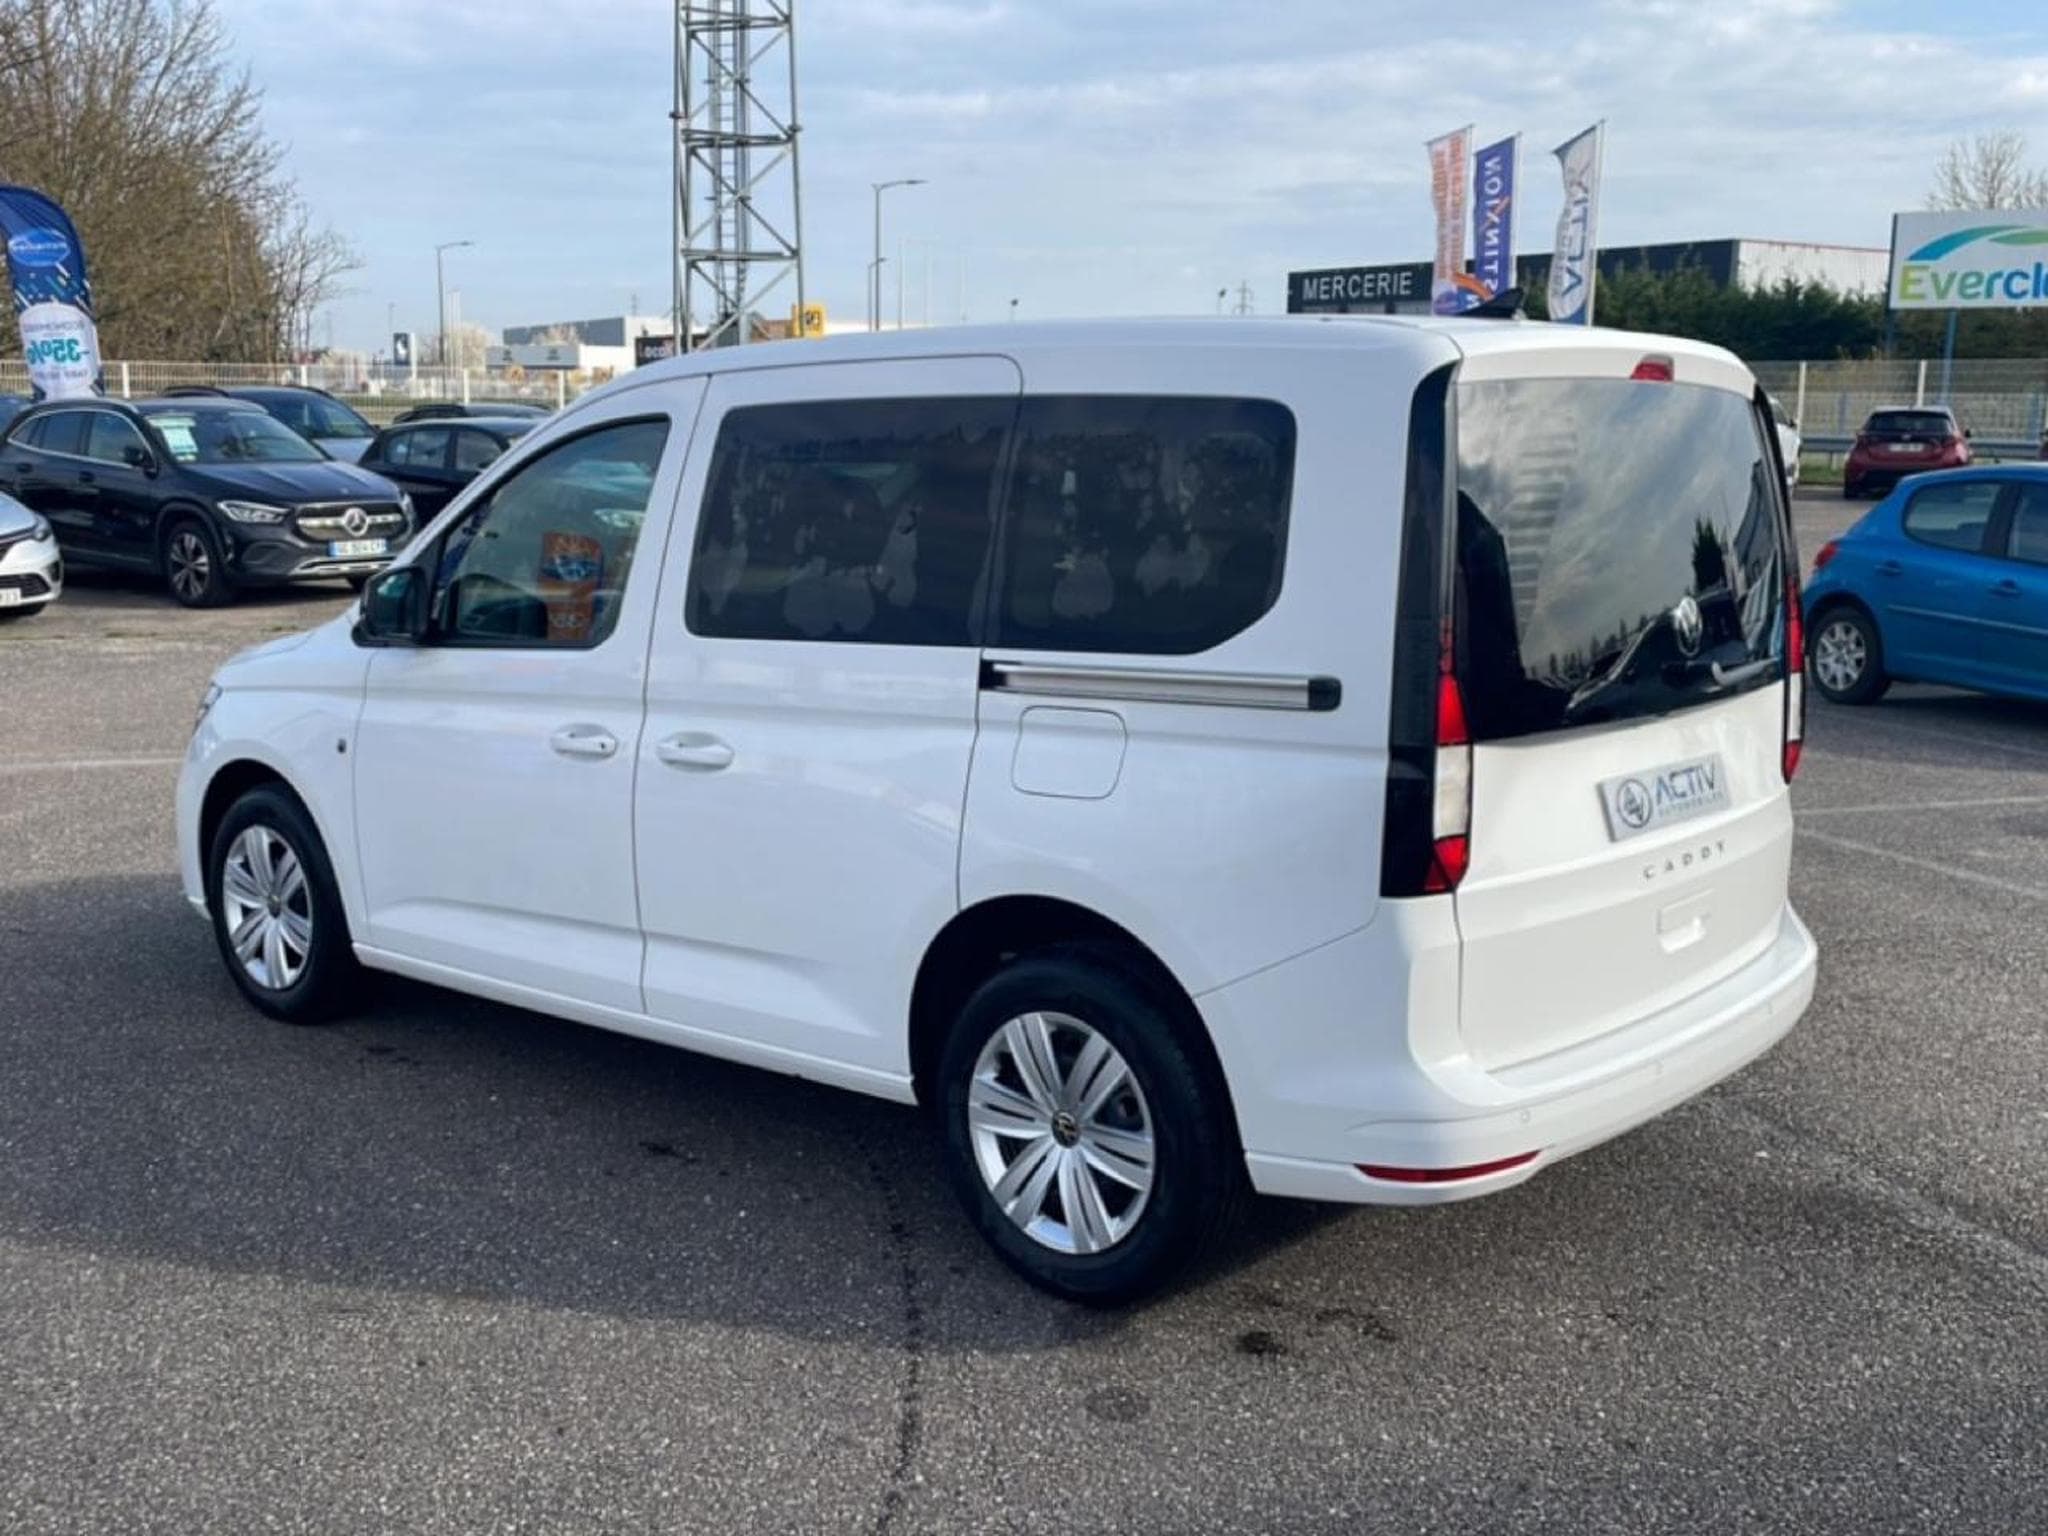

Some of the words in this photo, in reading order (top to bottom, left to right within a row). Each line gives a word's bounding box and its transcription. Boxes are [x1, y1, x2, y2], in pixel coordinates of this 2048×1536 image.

[1302, 271, 1413, 301] MERCERIE
[1899, 262, 2048, 300] Evercl
[1655, 761, 1716, 807] ACTIV
[1642, 839, 1725, 880] CADDY
